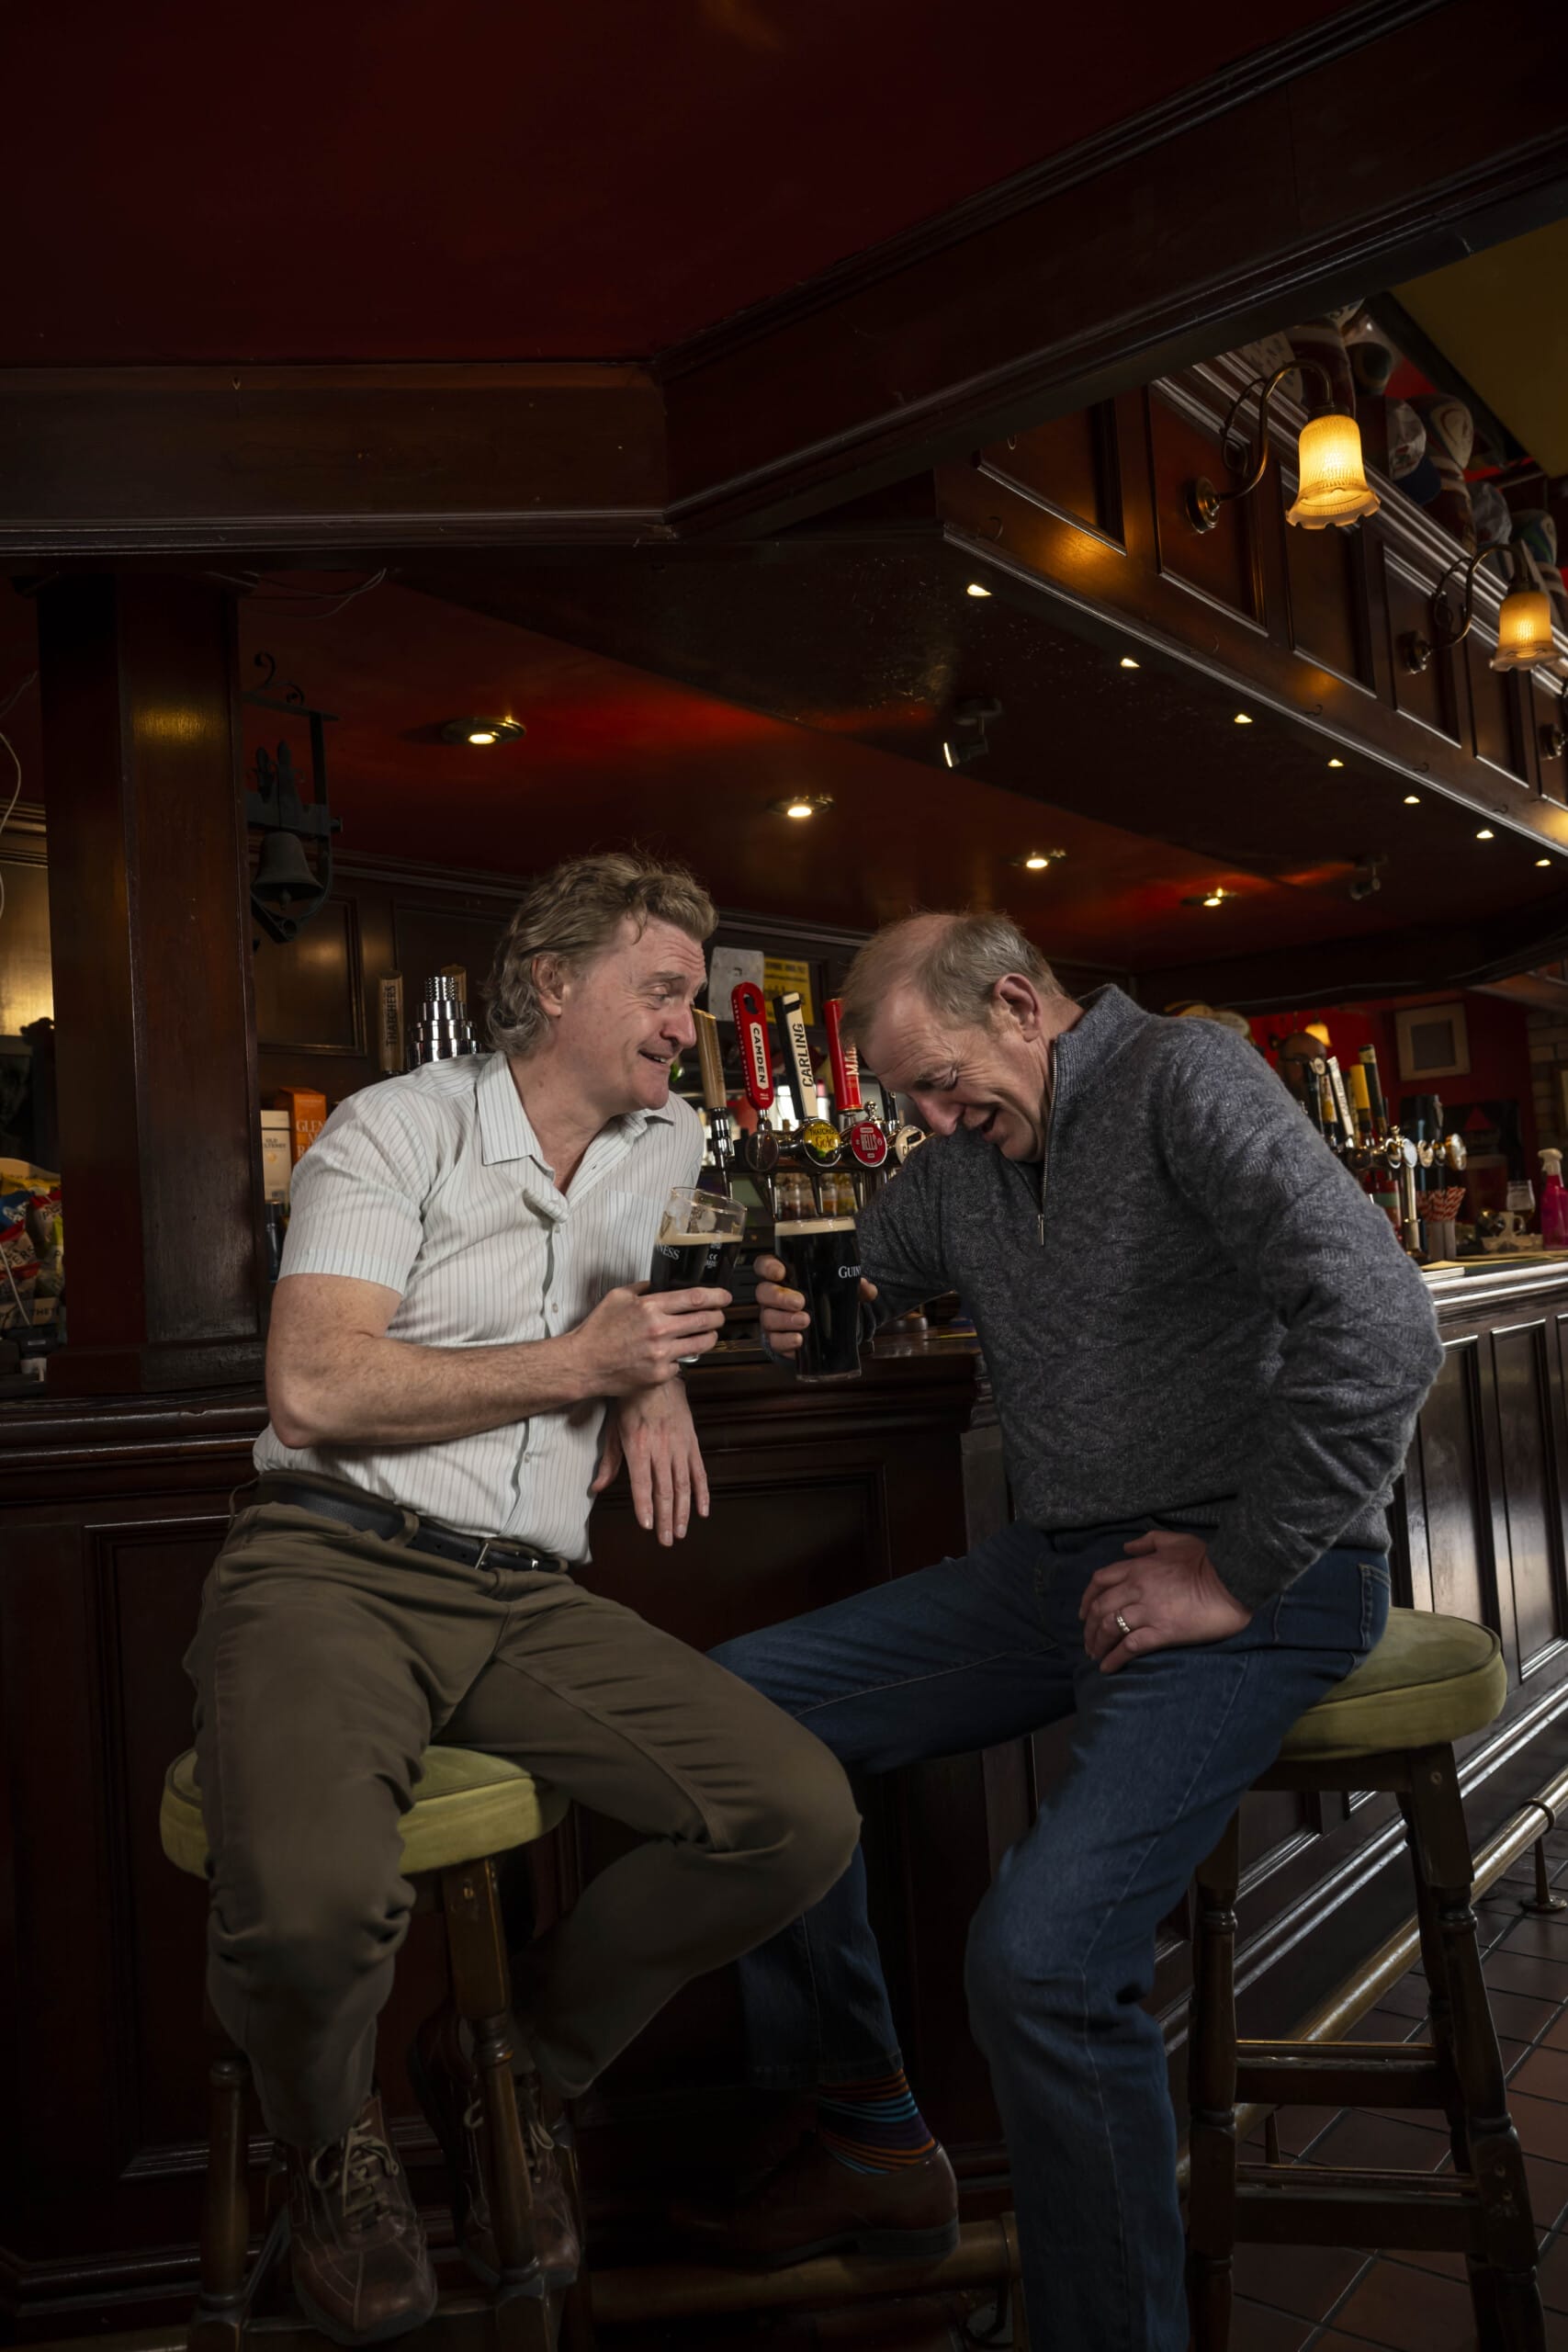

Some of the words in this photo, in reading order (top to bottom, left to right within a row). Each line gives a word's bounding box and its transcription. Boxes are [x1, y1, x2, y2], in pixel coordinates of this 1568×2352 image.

[753, 1027, 767, 1083] CAMDEN
[793, 1023, 814, 1088] CARLING
[860, 1133, 878, 1150] HELLS
